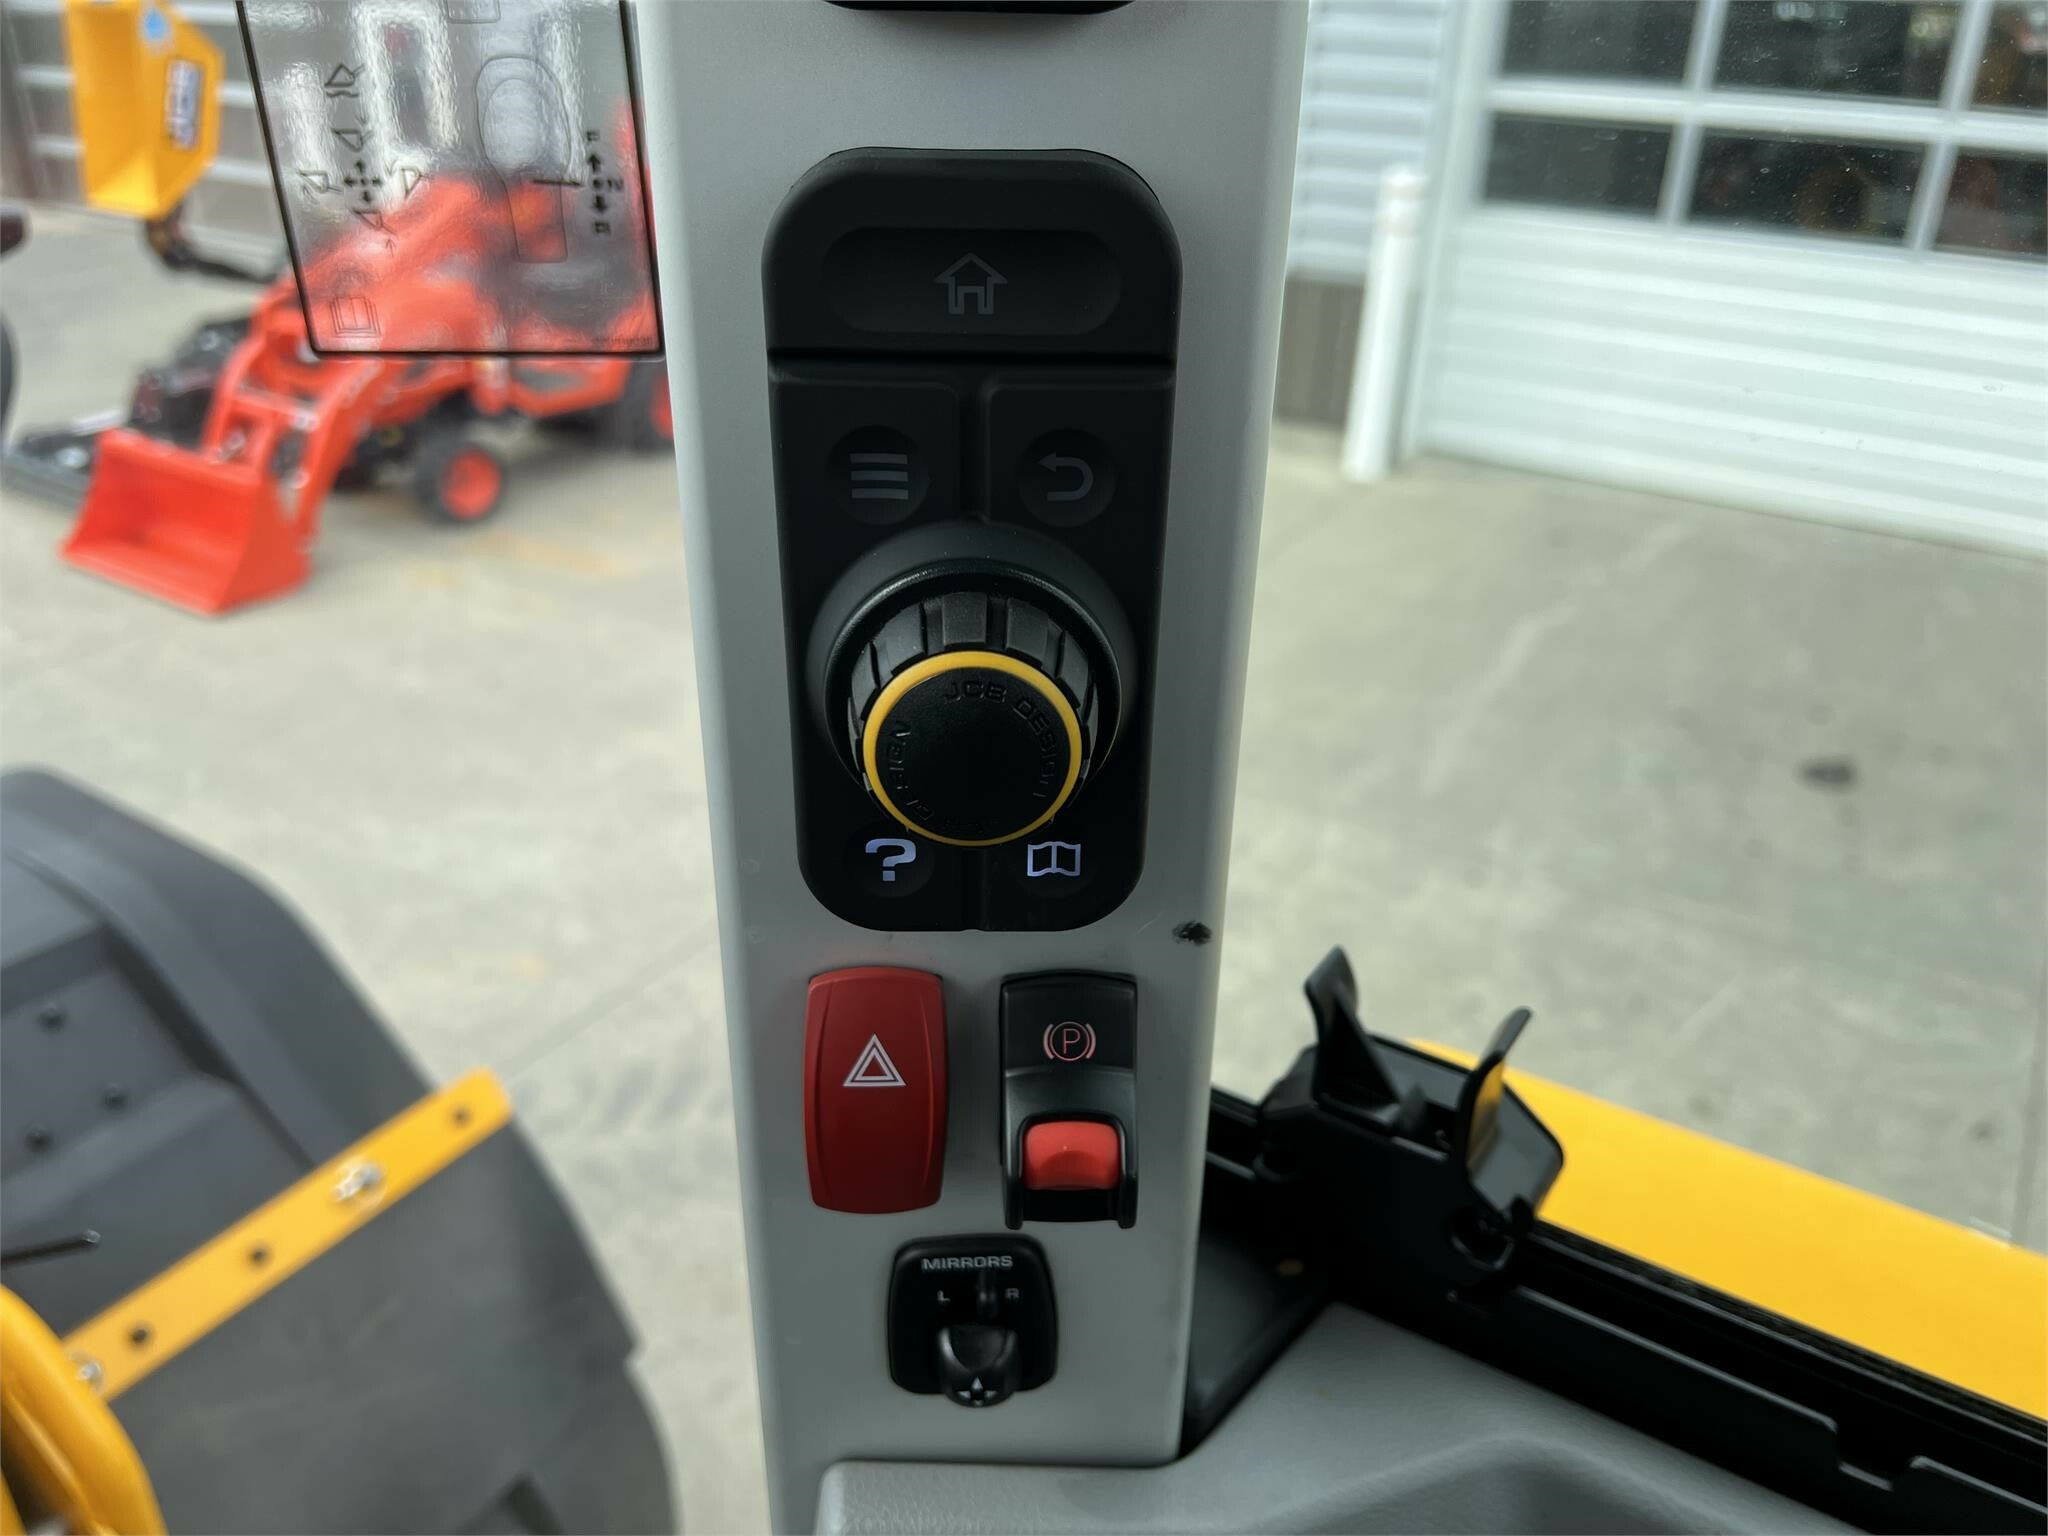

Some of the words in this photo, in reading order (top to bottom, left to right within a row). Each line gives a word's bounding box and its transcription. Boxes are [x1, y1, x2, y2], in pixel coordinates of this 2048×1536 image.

[944, 680, 1007, 703] JCB
[1063, 1028, 1081, 1054] P
[922, 1255, 1013, 1270] MIRRORS
[937, 1290, 951, 1302] L
[1006, 1288, 1019, 1299] R
